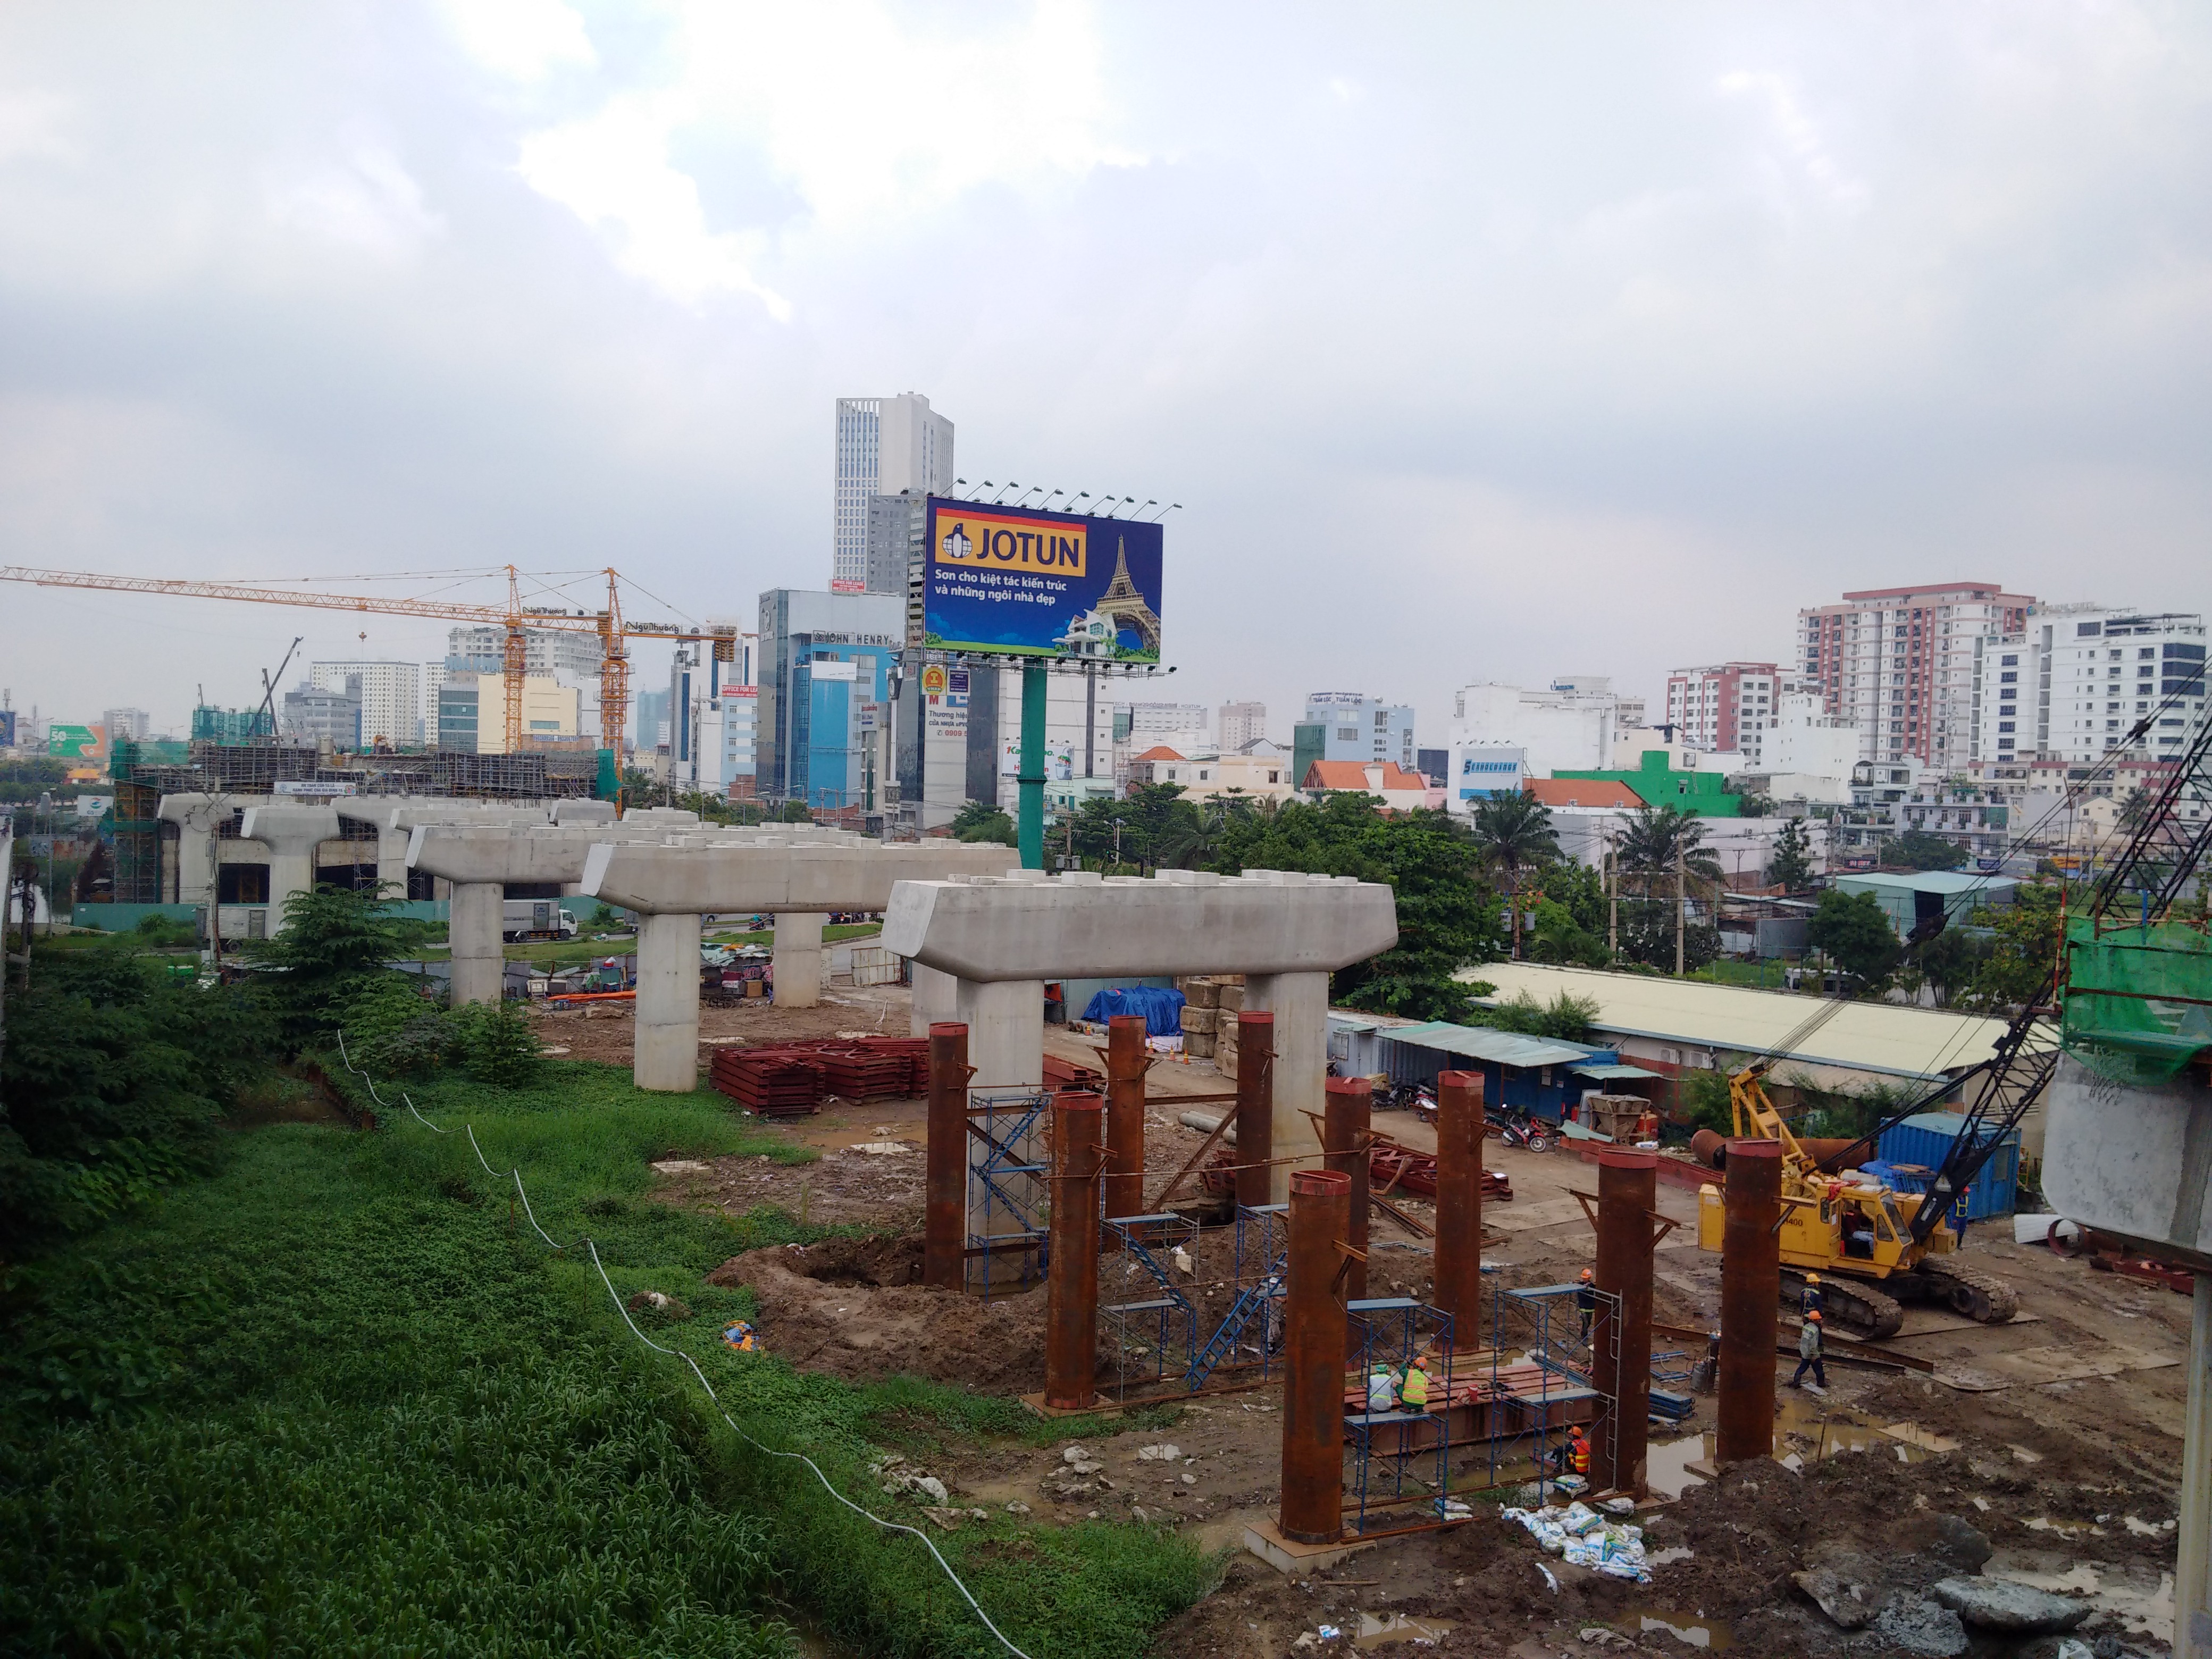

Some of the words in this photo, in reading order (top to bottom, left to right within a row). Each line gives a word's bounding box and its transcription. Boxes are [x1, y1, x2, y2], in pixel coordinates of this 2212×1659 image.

[976, 529, 1079, 567] JOTUN
[935, 569, 956, 581] Sơn
[959, 571, 978, 583] cho
[980, 571, 1001, 586] kiệt
[1003, 574, 1019, 586] tác
[1022, 576, 1043, 589] kiến
[1046, 580, 1067, 591] trúc
[935, 584, 948, 594] và
[951, 585, 985, 600] những
[988, 590, 1011, 602] ngôi
[1014, 591, 1033, 602] nhà
[1036, 594, 1055, 606] đẹp
[826, 632, 848, 643] JOHN
[857, 634, 889, 645] HENRY
[928, 710, 954, 719] Thương
[51, 731, 66, 742] 50
